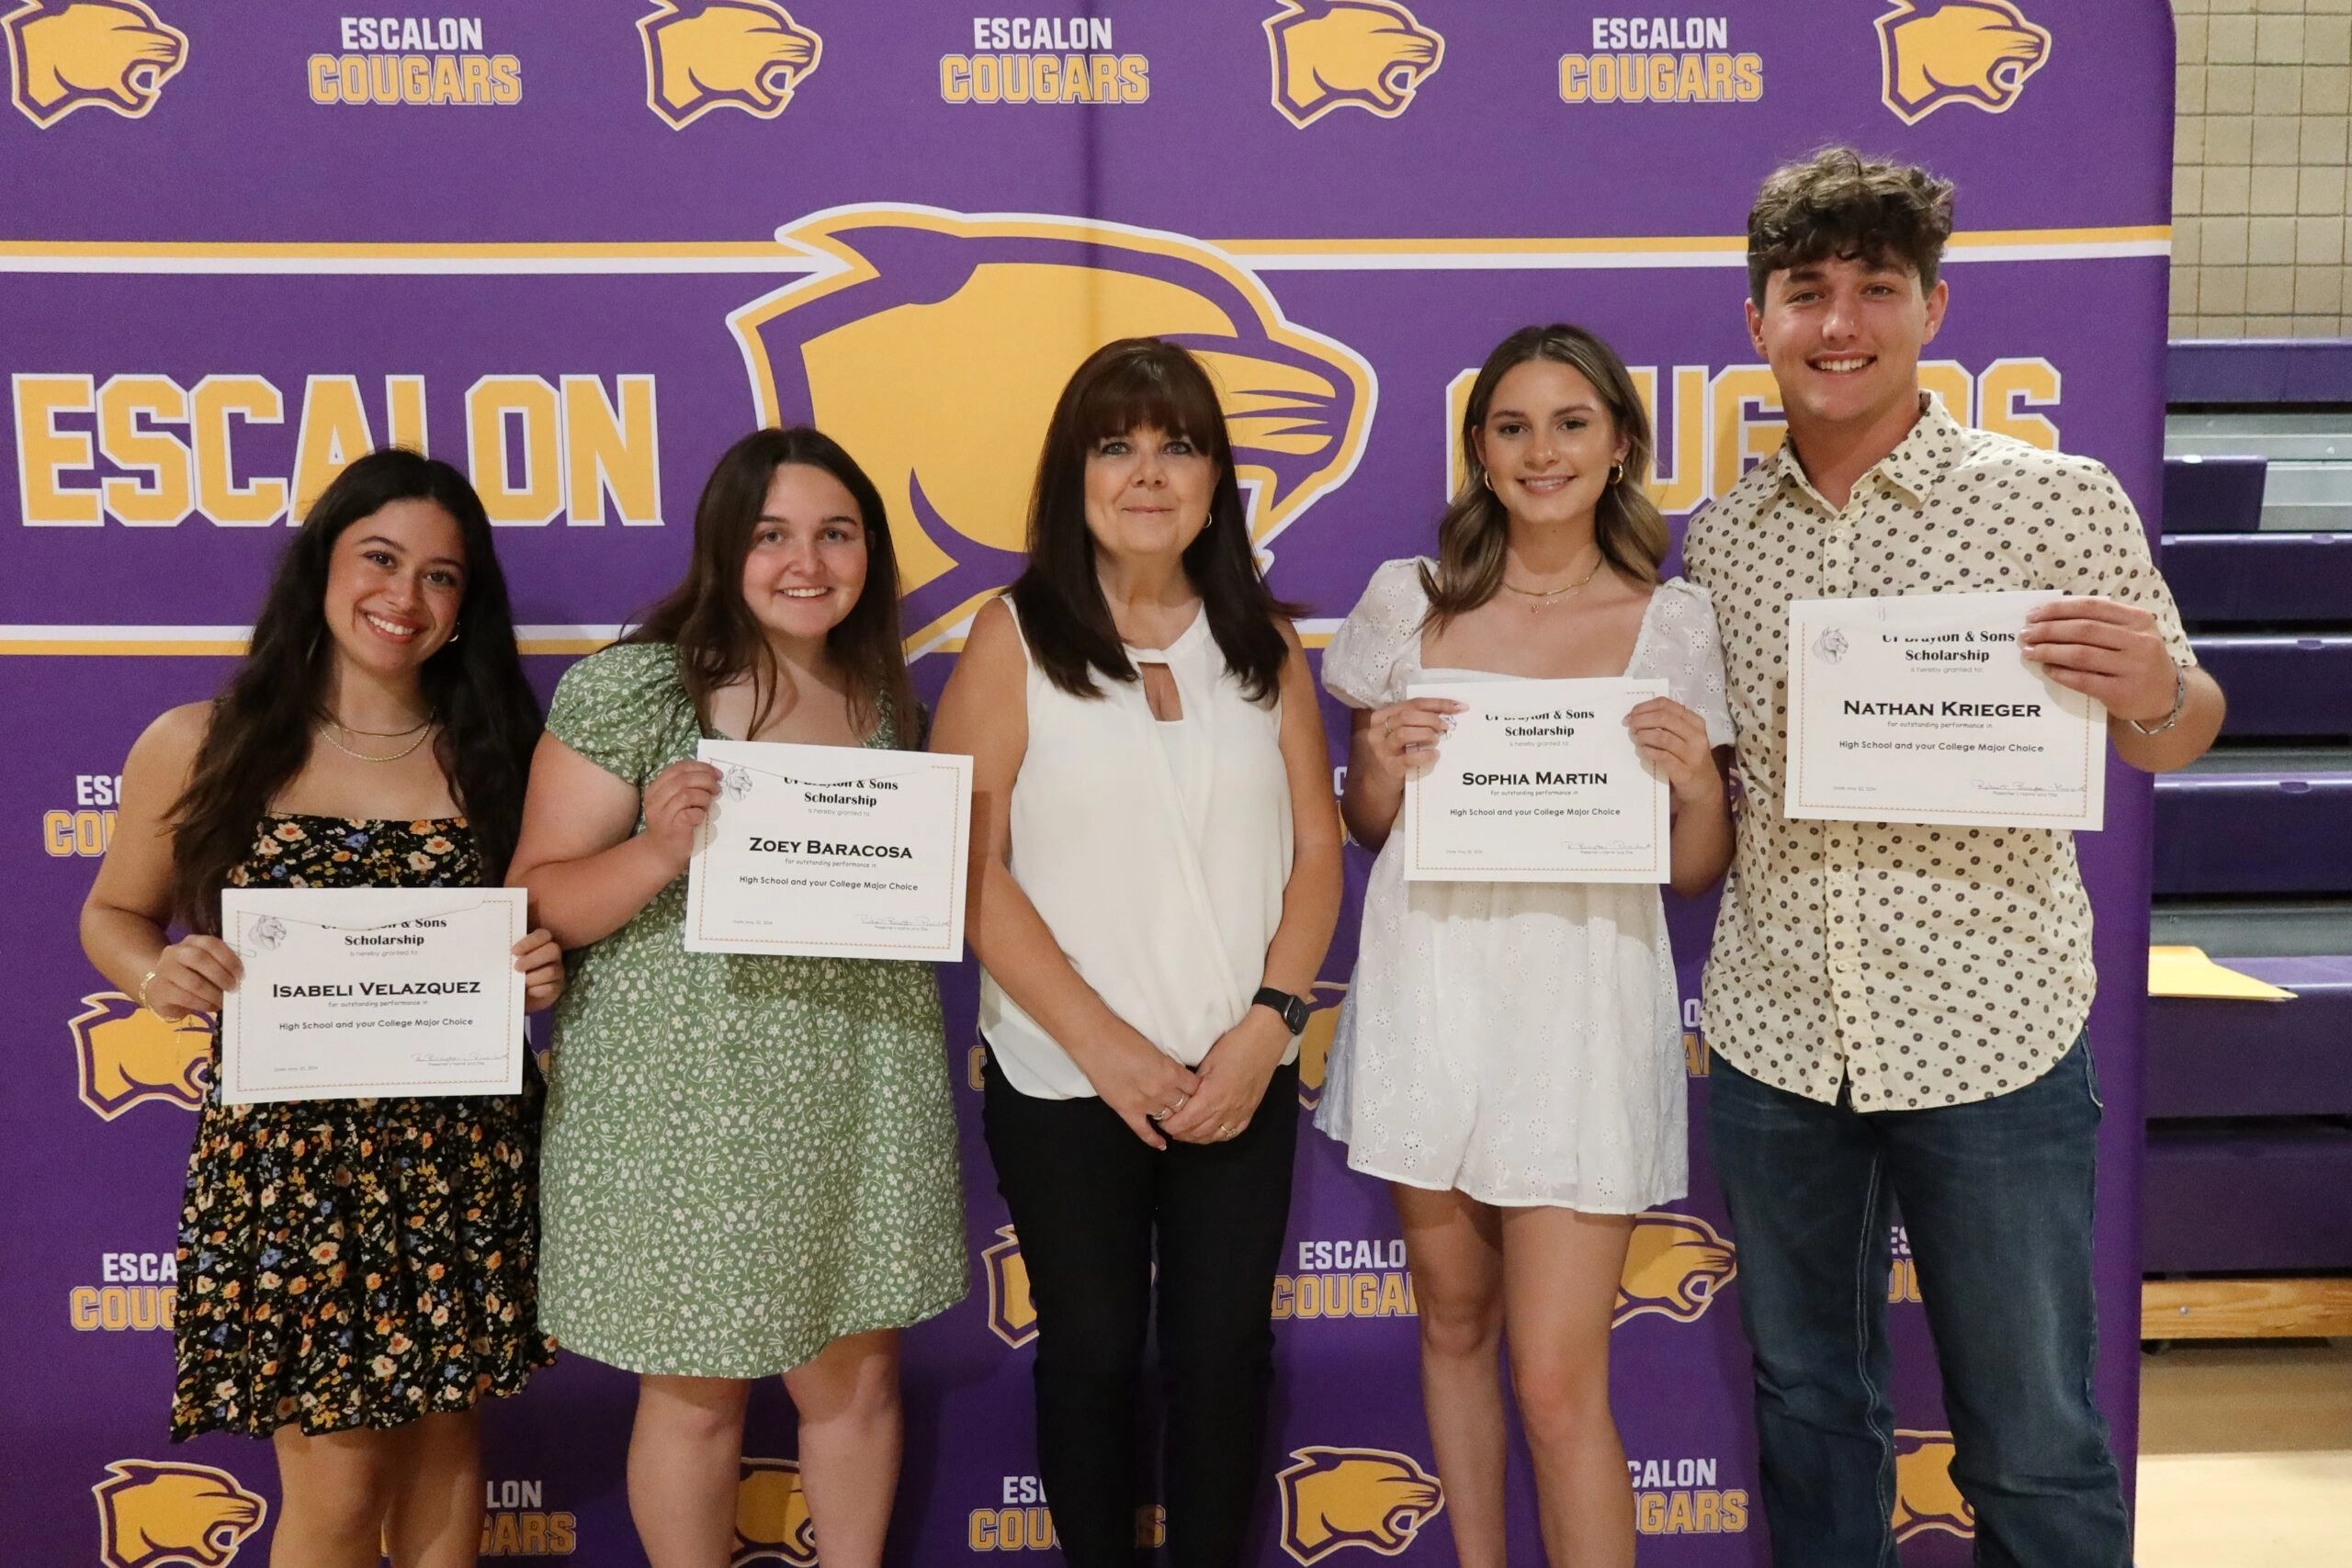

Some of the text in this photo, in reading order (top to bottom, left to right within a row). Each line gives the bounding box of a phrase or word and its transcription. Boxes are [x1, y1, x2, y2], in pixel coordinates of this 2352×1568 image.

[341, 17, 482, 51] ESCALON
[974, 17, 1112, 51] ESCALON
[1592, 17, 1727, 50] ESCALON
[309, 55, 522, 105] COUGARS
[940, 54, 1149, 104] COUGARS
[1558, 53, 1763, 103] COUGARS
[1964, 630, 1975, 642] &
[1980, 630, 2016, 642] Sons
[1905, 649, 1990, 663] Scholarship
[1566, 709, 1595, 719] Sons
[1844, 700, 2041, 717] NATHAN KRIEGER
[1504, 725, 1575, 739] Scholarship
[1838, 739, 2044, 753] High School and your College Major Choice
[869, 778, 899, 791] Sons
[1462, 772, 1608, 785] SOPHIA MARTIN
[803, 791, 878, 808] Scholarship
[1450, 807, 1621, 818] High School and your College Major Choice
[749, 837, 913, 859] ZOEY BARACOSA
[739, 874, 919, 891] High School and your College Major Choice
[414, 918, 447, 929] Sons
[345, 934, 424, 947] Scholarship
[273, 981, 481, 998] ISABELI VELAZQUEZ
[278, 1018, 474, 1032] High School and your College Major Choice
[1298, 1240, 1408, 1260] ESCALO
[102, 1253, 178, 1282] ESCA
[1272, 1272, 1419, 1319] COUGA
[1627, 1458, 1716, 1488] CALON
[1635, 1489, 1748, 1535] GARS
